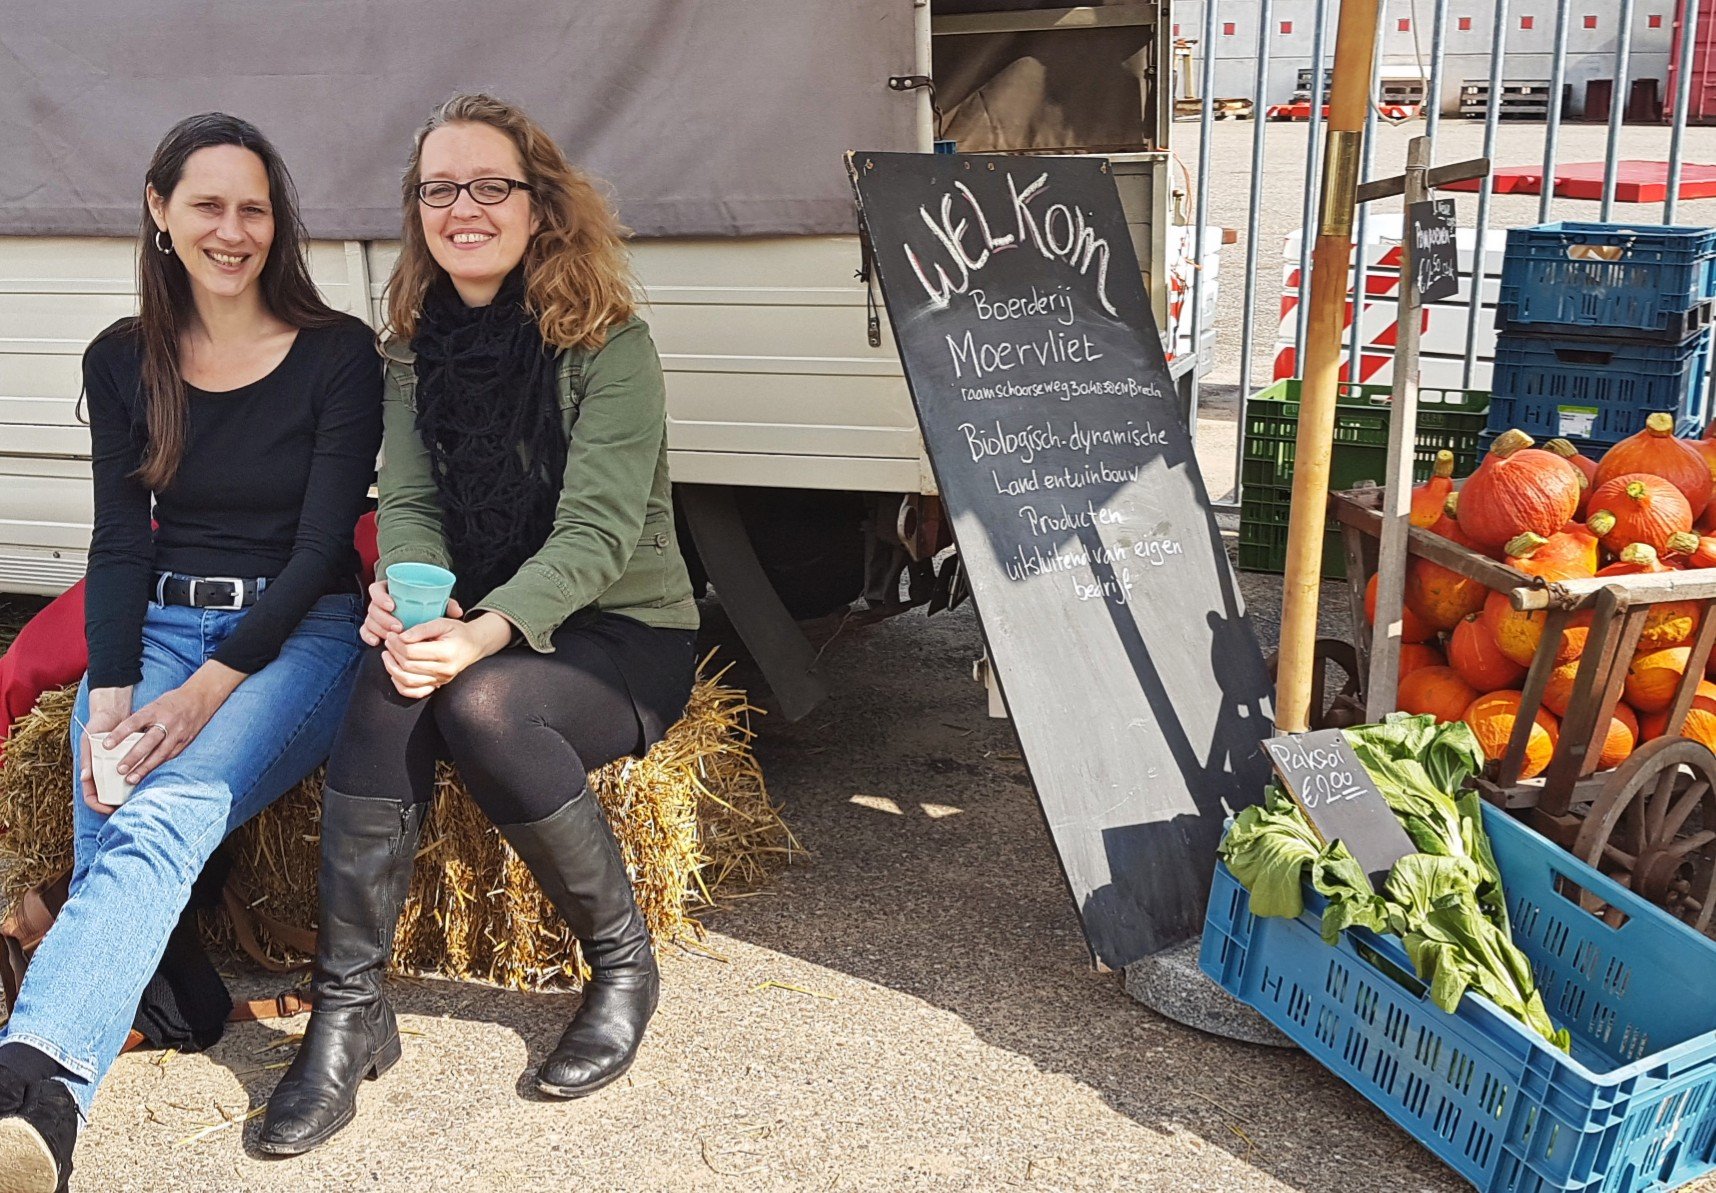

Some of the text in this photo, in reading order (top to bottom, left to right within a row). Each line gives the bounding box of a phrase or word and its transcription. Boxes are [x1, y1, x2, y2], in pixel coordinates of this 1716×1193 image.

[968, 285, 1074, 325] Boerderij
[945, 330, 1103, 379] Moervliet
[992, 469, 1039, 496] Land
[1019, 500, 1123, 536] Producten
[1134, 532, 1183, 566] eigen
[1072, 567, 1133, 604] bedrijf
